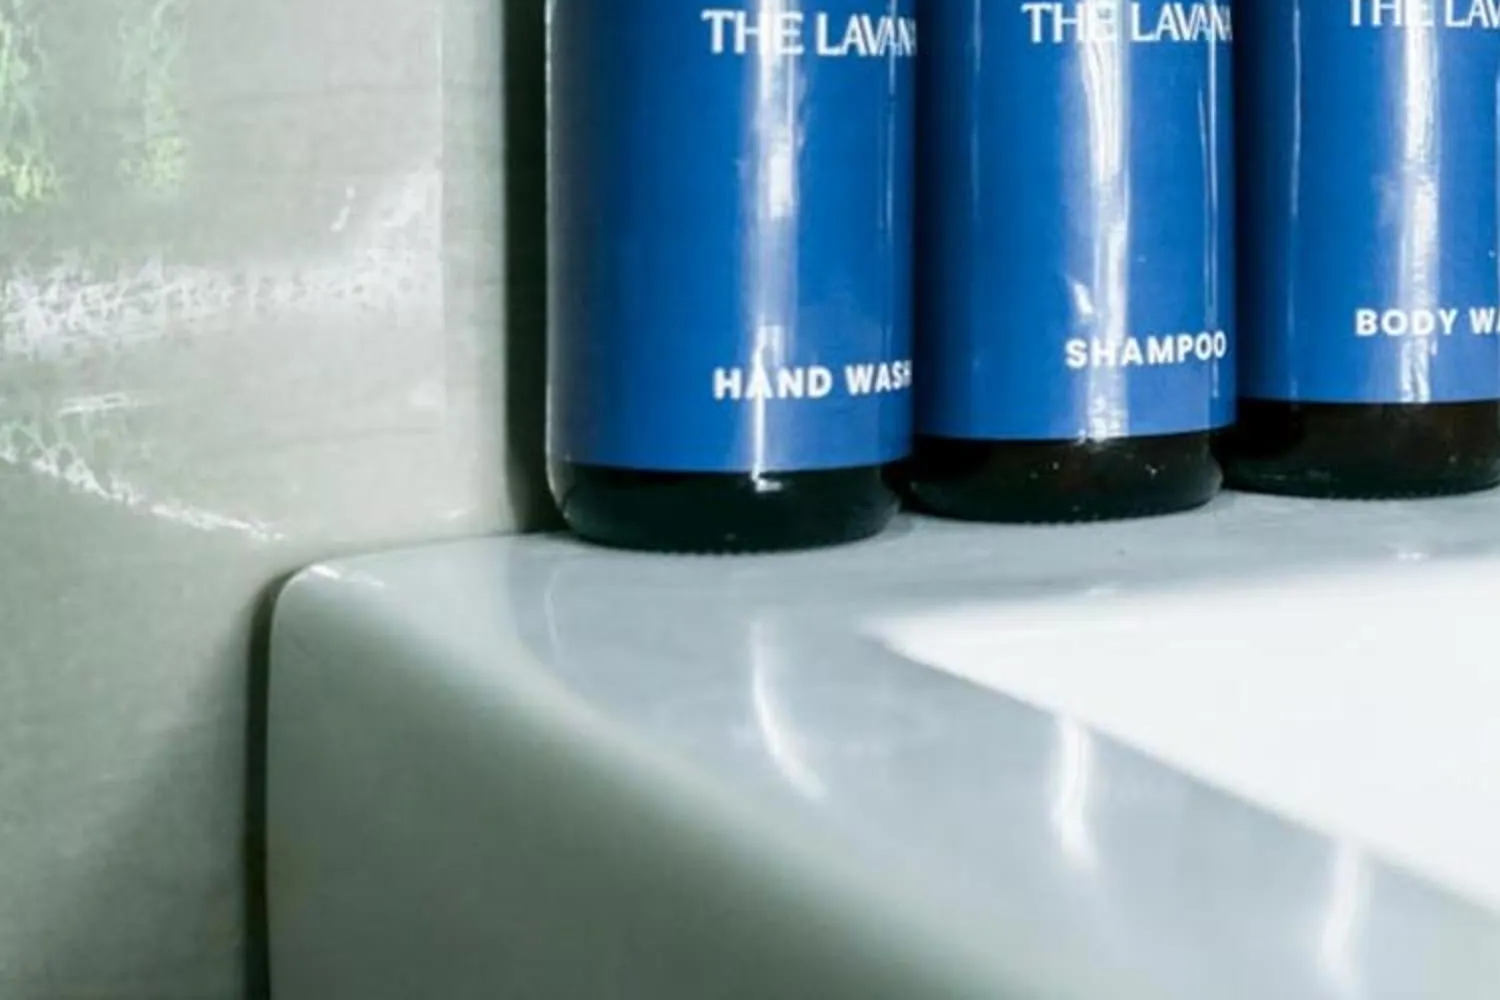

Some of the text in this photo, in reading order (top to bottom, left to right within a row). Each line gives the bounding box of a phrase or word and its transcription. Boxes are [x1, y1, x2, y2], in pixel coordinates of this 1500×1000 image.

[701, 8, 804, 54] THE
[1020, 1, 1119, 43] THE
[1354, 308, 1458, 337] BODY
[1065, 330, 1227, 369] SHAMPOO
[713, 366, 833, 400] HAND
